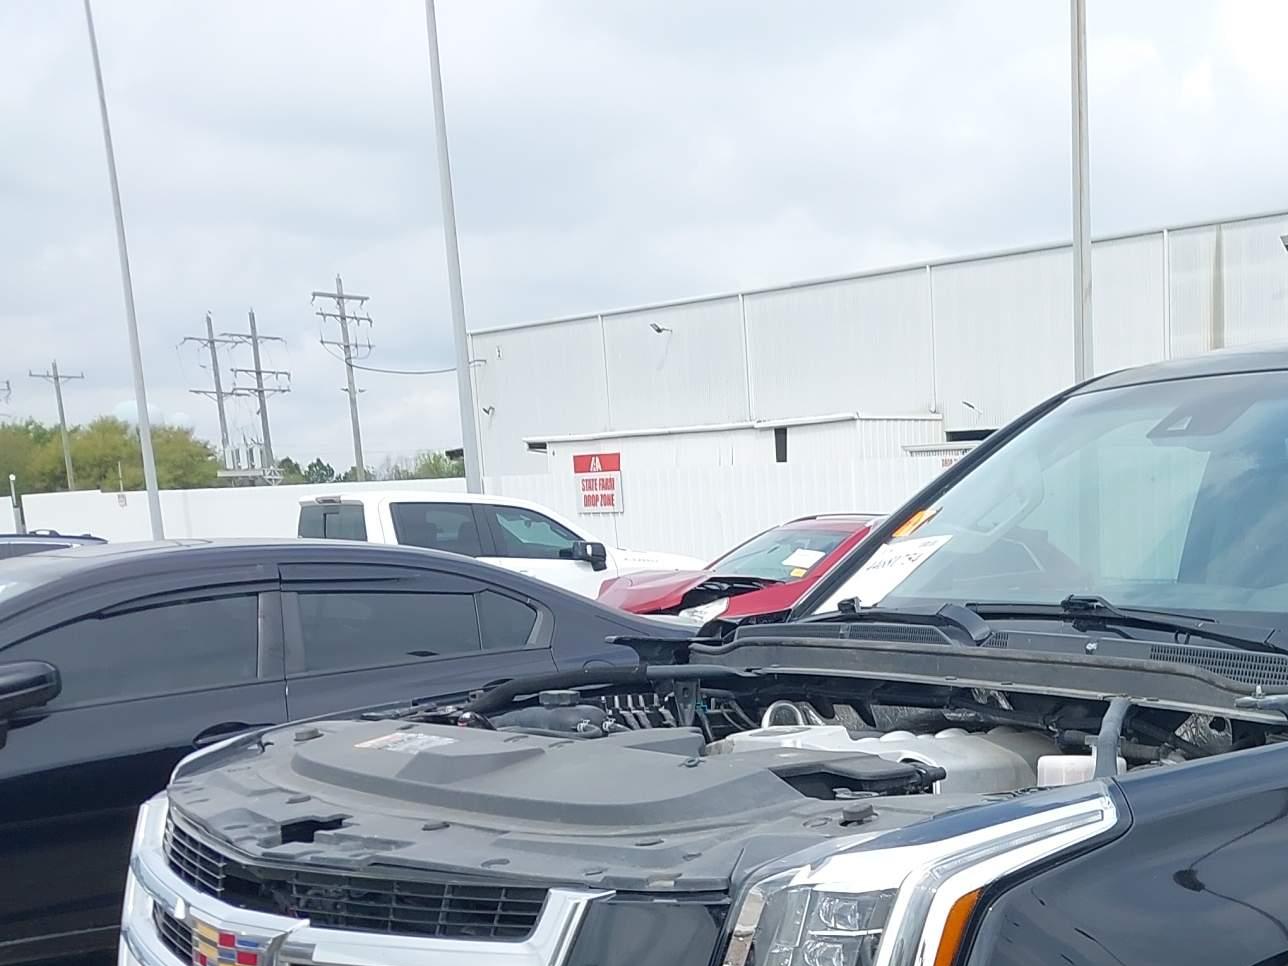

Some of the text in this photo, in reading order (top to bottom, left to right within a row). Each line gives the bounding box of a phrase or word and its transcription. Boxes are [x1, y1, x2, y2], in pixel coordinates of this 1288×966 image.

[581, 478, 598, 492] STATE
[583, 493, 615, 507] DROP ZONE
